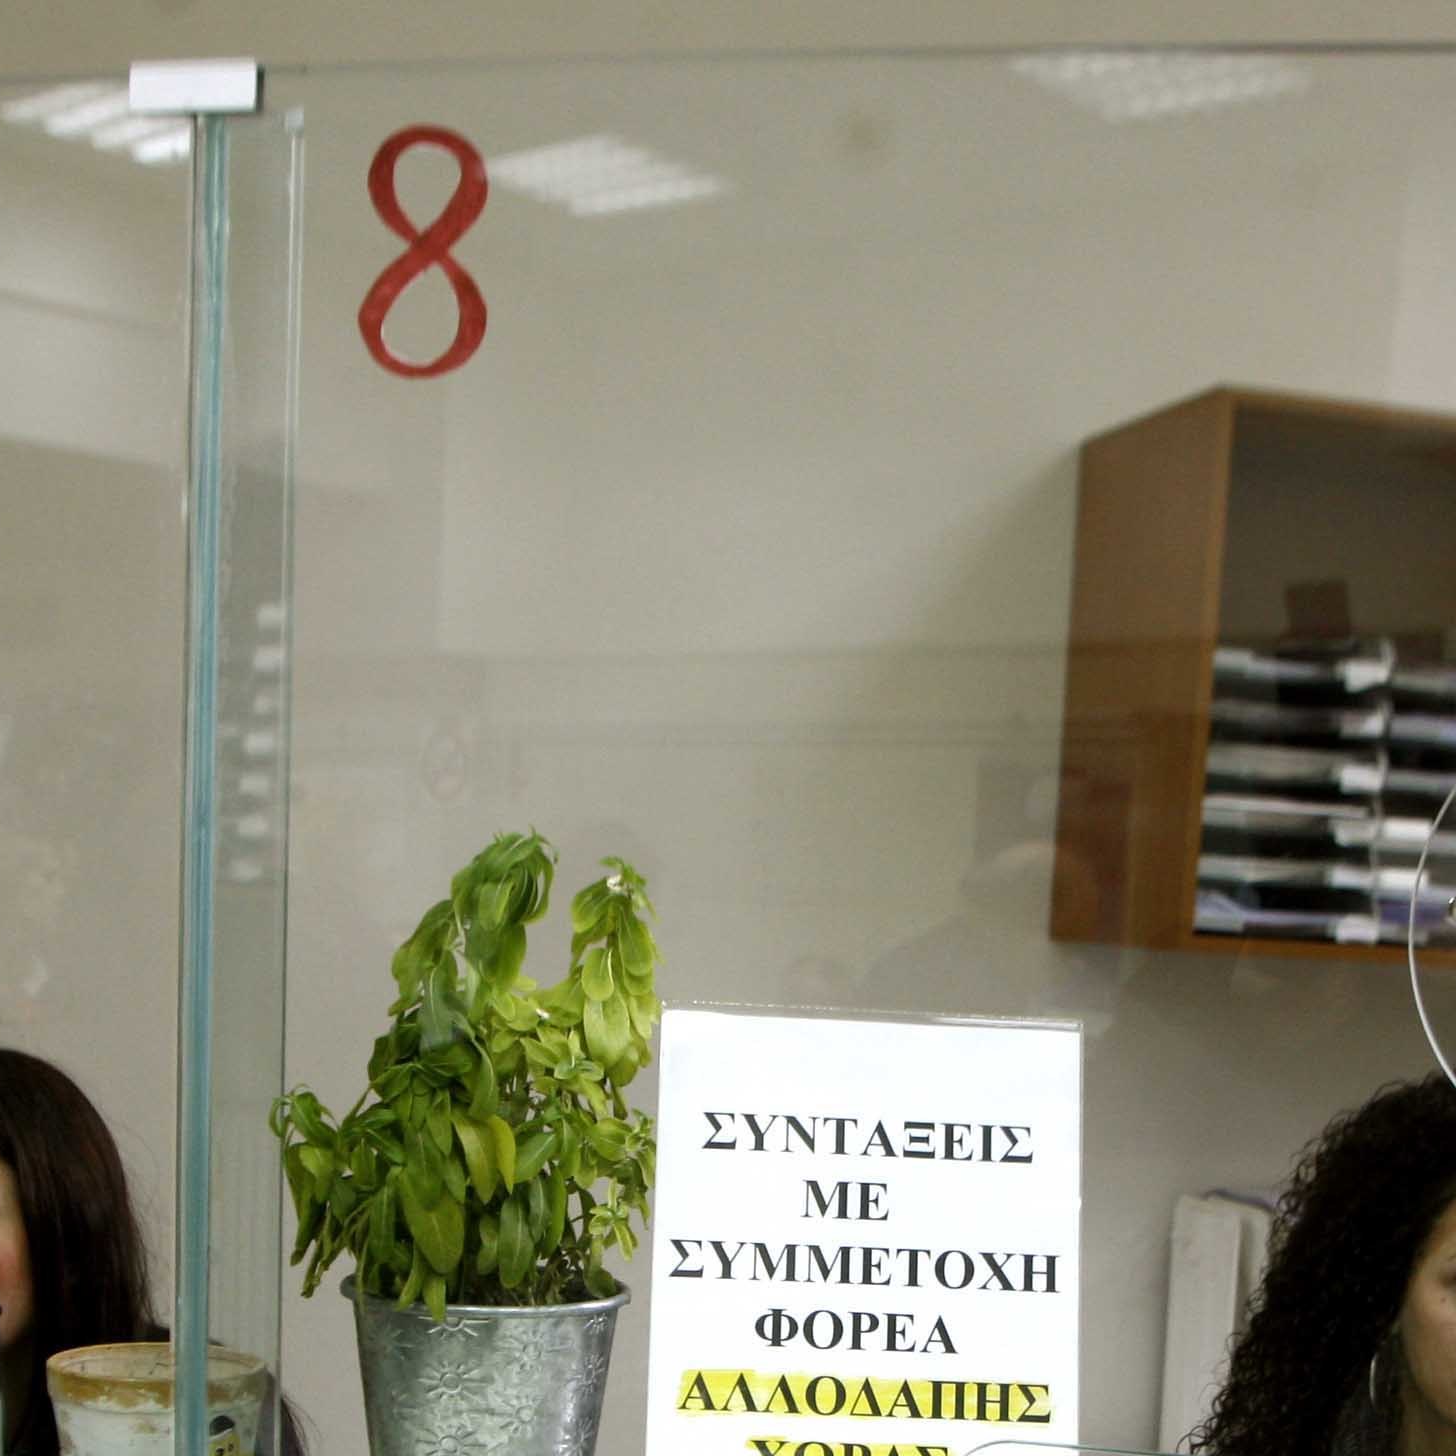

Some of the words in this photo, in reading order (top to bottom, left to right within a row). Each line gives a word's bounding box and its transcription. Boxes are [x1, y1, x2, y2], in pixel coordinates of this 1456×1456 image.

[357, 124, 488, 379] 8
[701, 1110, 1034, 1165] ΣΥΝΤΑΞΕΙΣ
[800, 1178, 890, 1222] ΜΕ
[668, 1238, 1061, 1294] ΣΥΜΜΕΤΟΧΗ
[753, 1307, 959, 1355] ΦΟΡΕΑ
[677, 1371, 1052, 1425] ΑΛΛΟΔΑΠΗΣ
